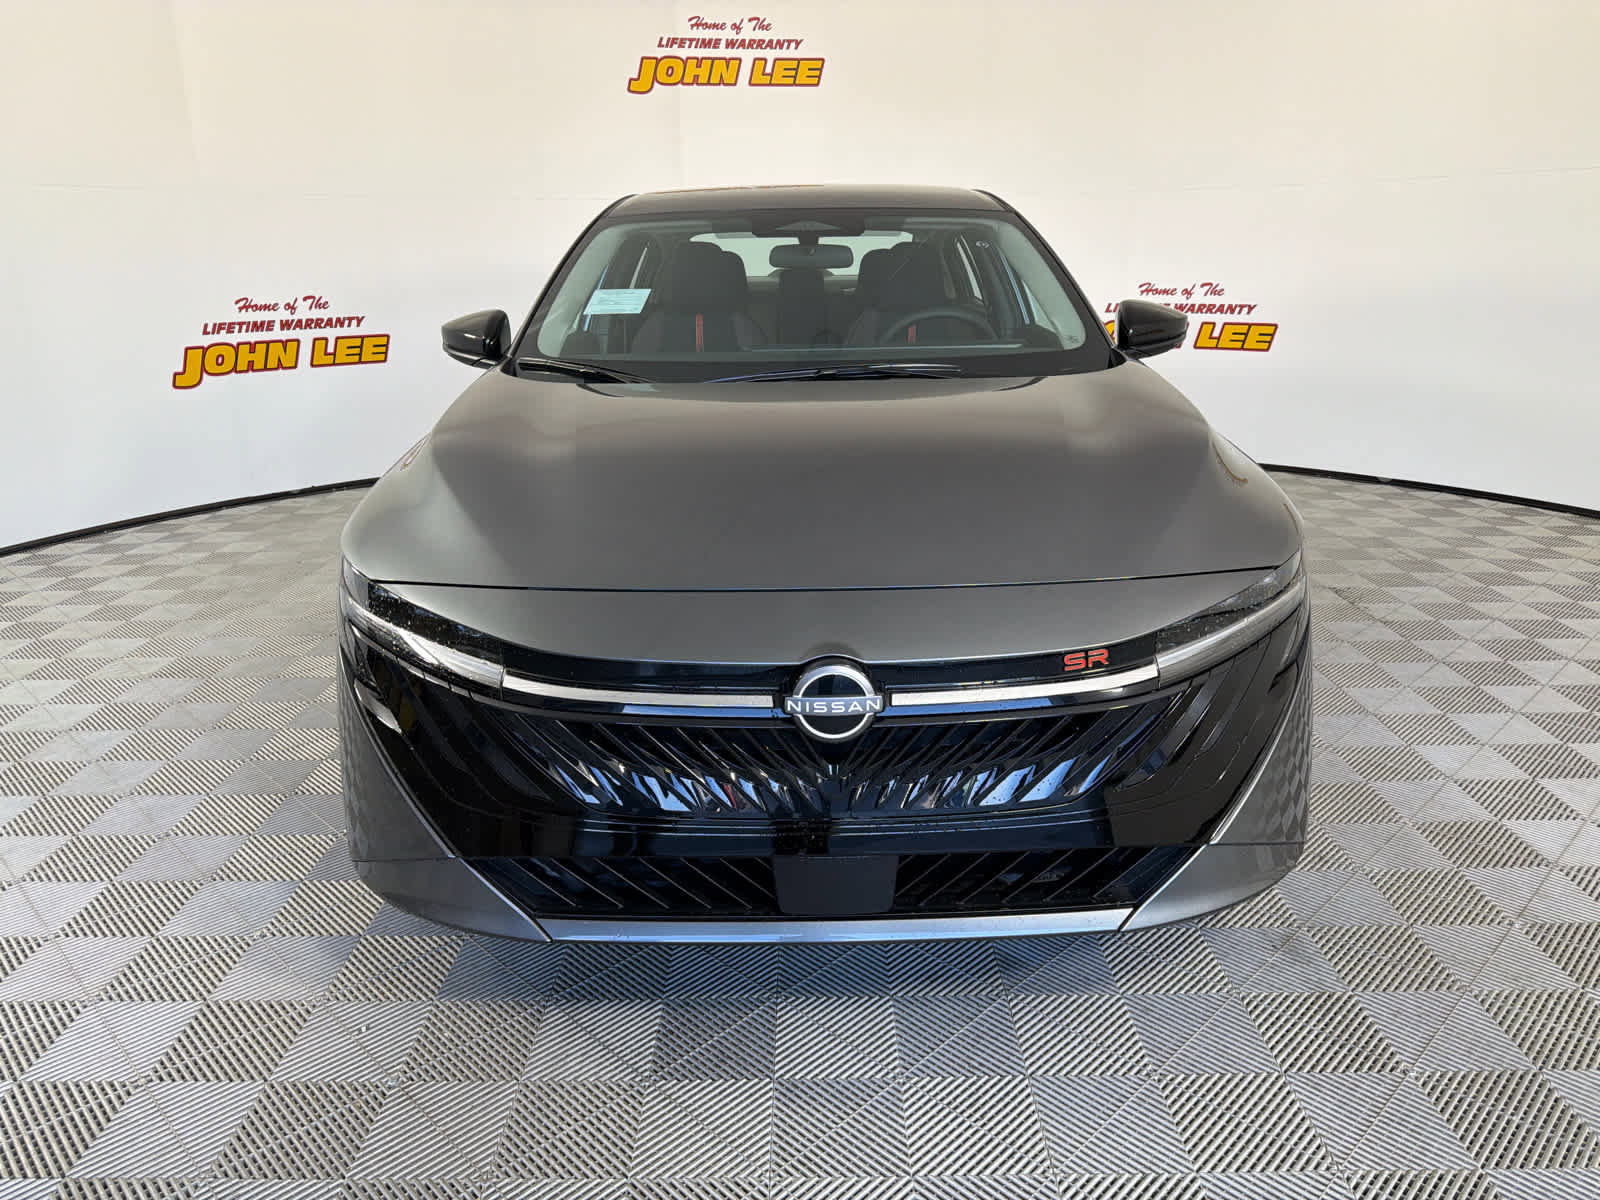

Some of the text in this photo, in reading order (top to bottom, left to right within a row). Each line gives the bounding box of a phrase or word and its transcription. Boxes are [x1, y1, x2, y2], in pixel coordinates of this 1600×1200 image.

[688, 16, 773, 35] Home of The
[657, 37, 804, 50] LIFETIME WARRANTY
[627, 55, 825, 94] JOHN LEE
[1138, 282, 1225, 300] Home of The
[234, 295, 330, 315] Home of The
[202, 316, 365, 335] LIFETIME WARRANTY
[1193, 321, 1279, 352] LEE
[172, 333, 391, 389] JOHN LEE
[1064, 648, 1109, 671] SR
[787, 698, 881, 713] NISSAN
